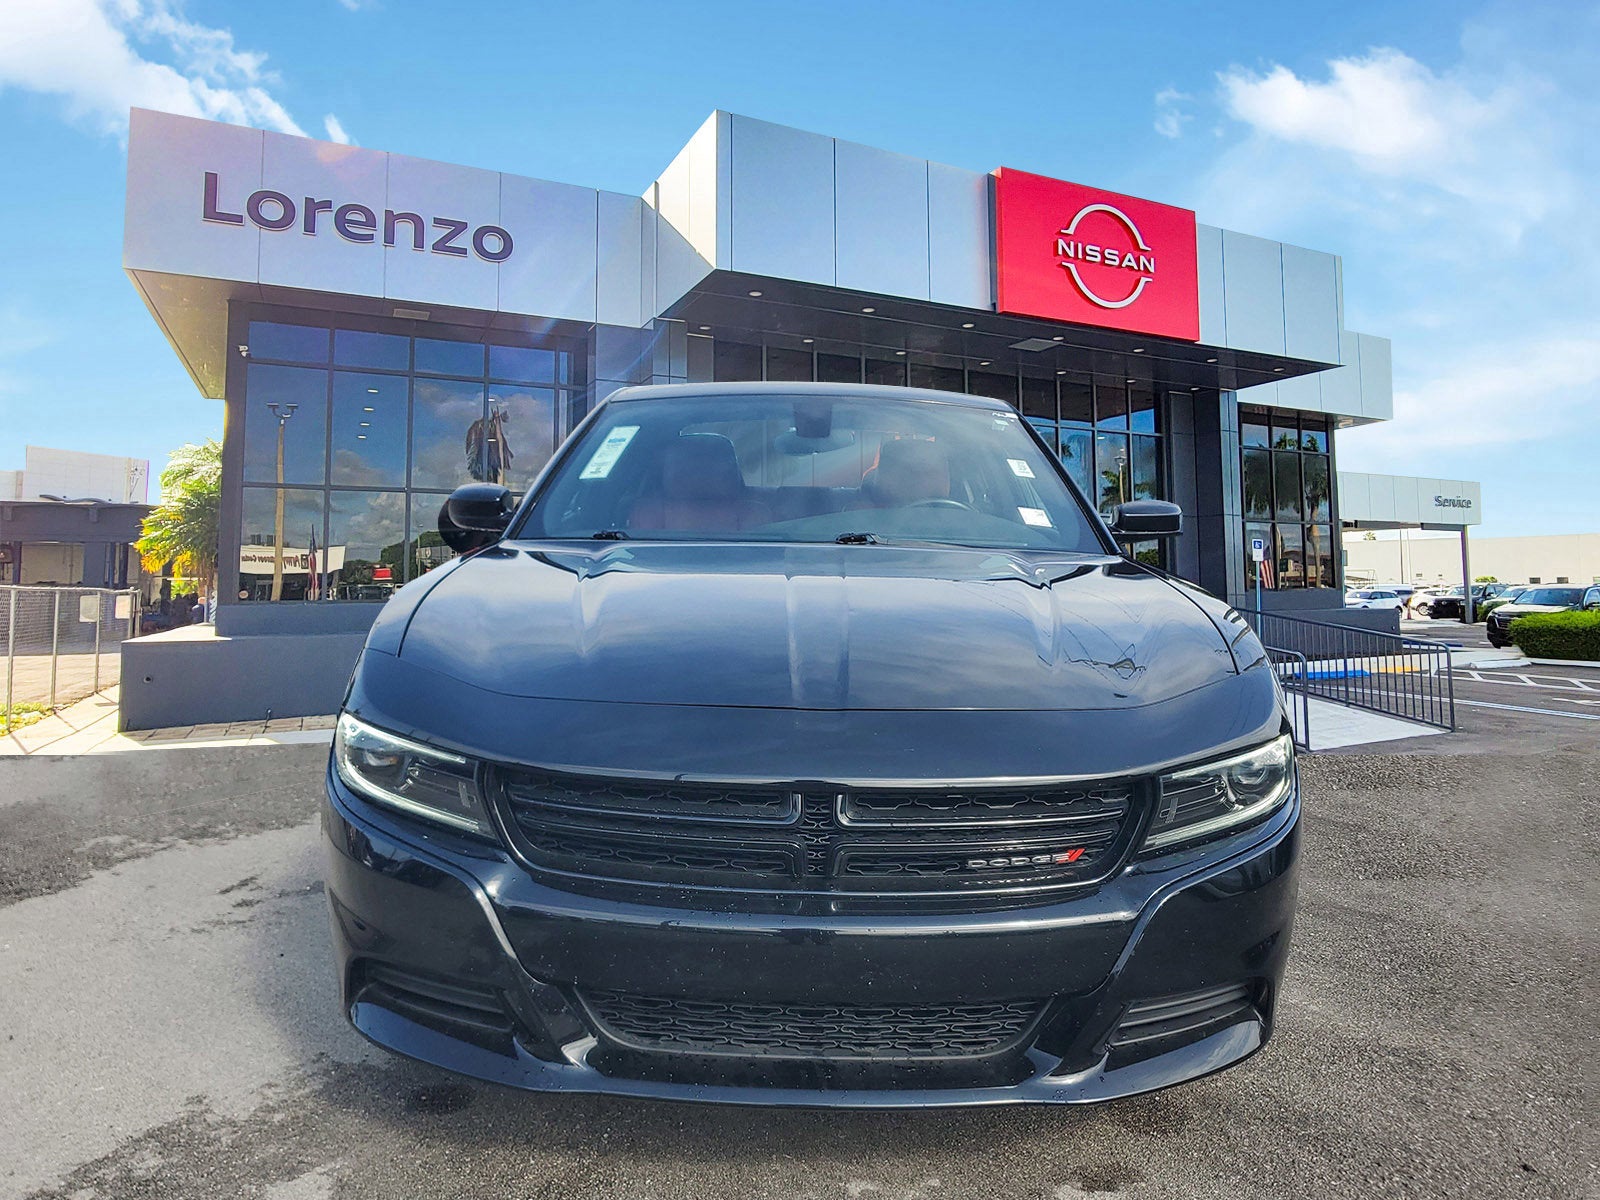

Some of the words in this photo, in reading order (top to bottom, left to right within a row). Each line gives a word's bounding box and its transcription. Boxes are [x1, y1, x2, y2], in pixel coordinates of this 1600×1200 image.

[202, 171, 514, 262] Lorenzo
[1057, 238, 1155, 273] NISSAN
[1434, 495, 1472, 508] Service
[967, 854, 1071, 868] DODGE
